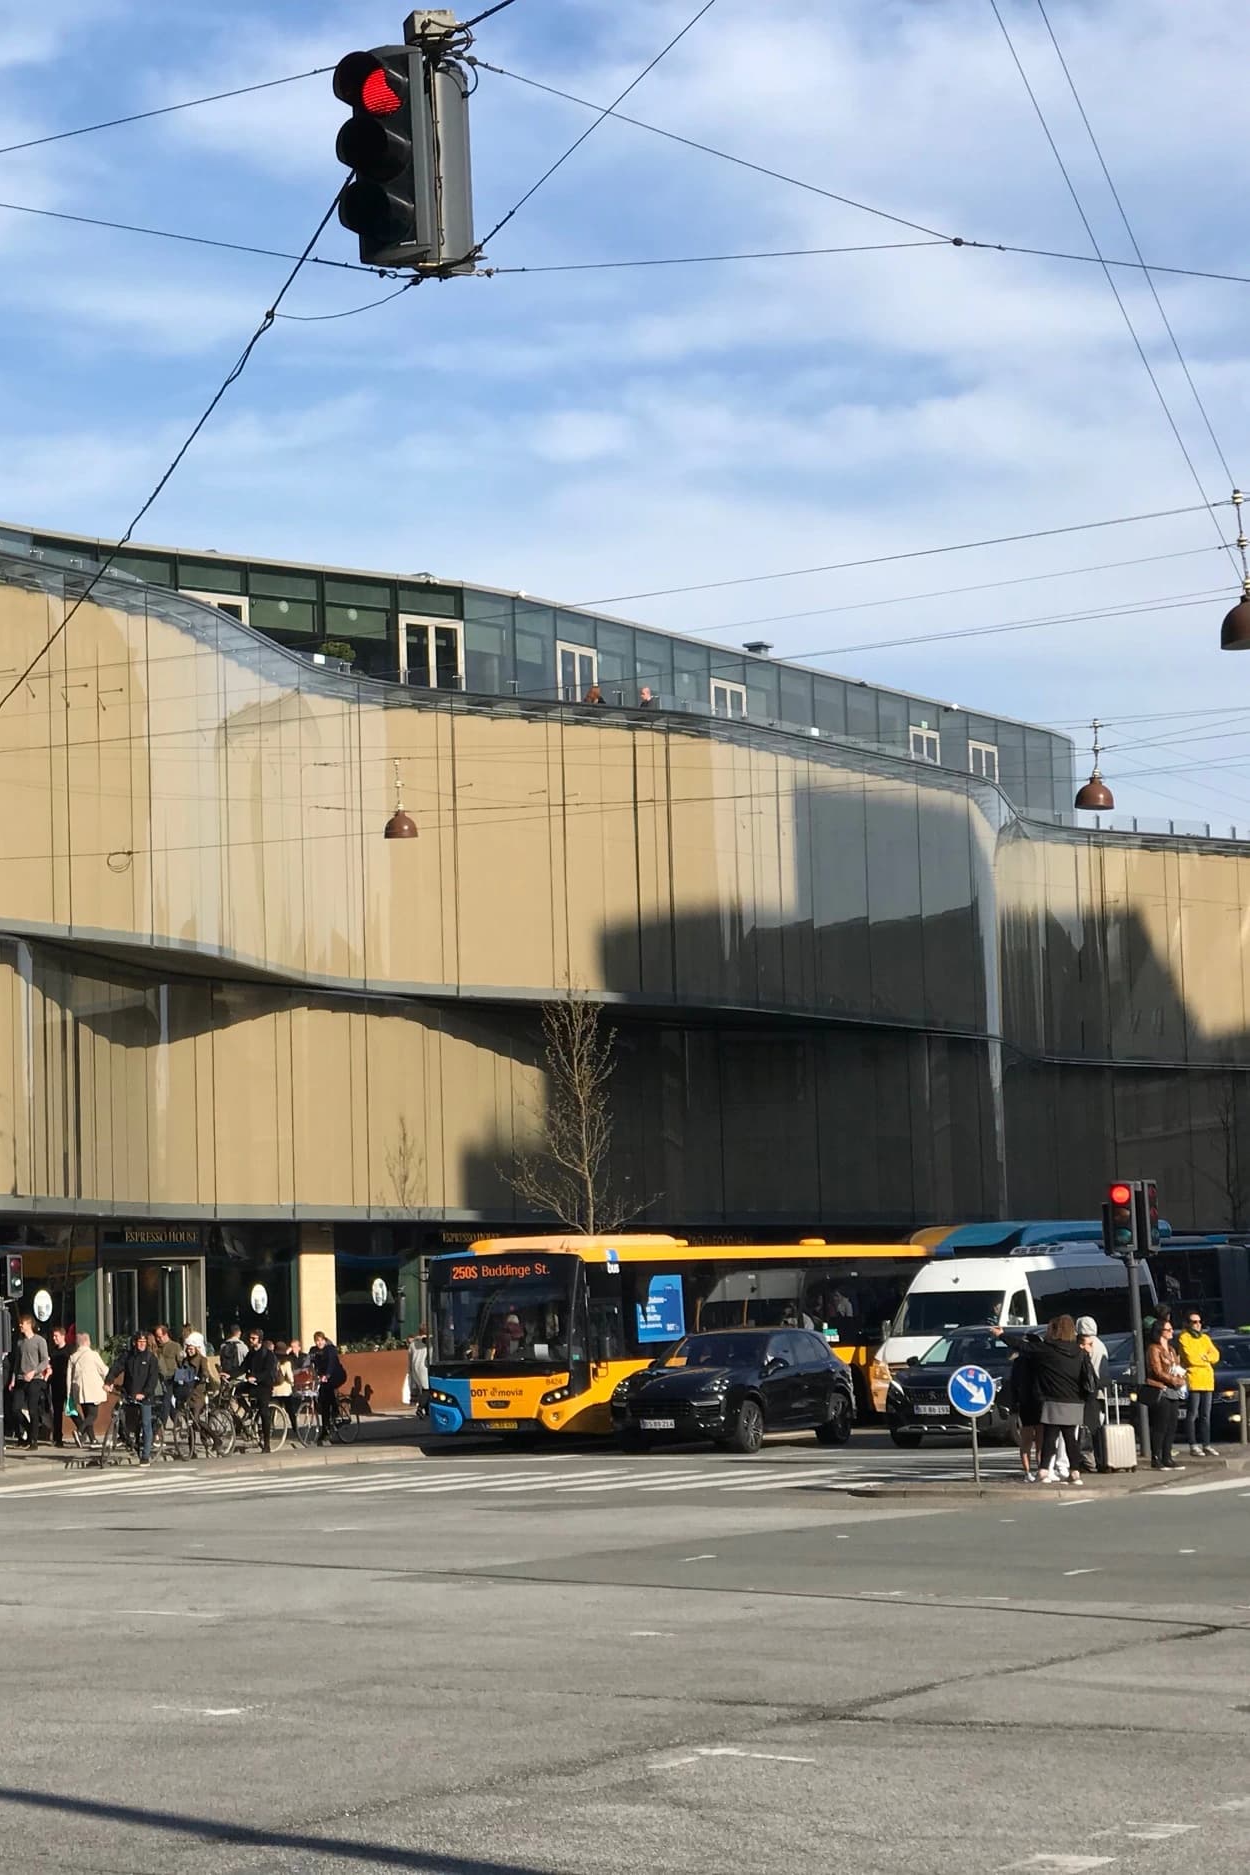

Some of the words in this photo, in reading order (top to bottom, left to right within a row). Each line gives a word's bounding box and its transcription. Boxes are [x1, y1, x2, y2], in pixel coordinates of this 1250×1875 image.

[125, 1231, 168, 1243] ESPRESSO
[452, 1265, 478, 1280] 250S
[481, 1264, 531, 1279] Buddinge
[534, 1262, 550, 1276] St.
[606, 1262, 620, 1274] bus
[470, 1388, 488, 1398] DOT
[497, 1387, 524, 1397] movia
